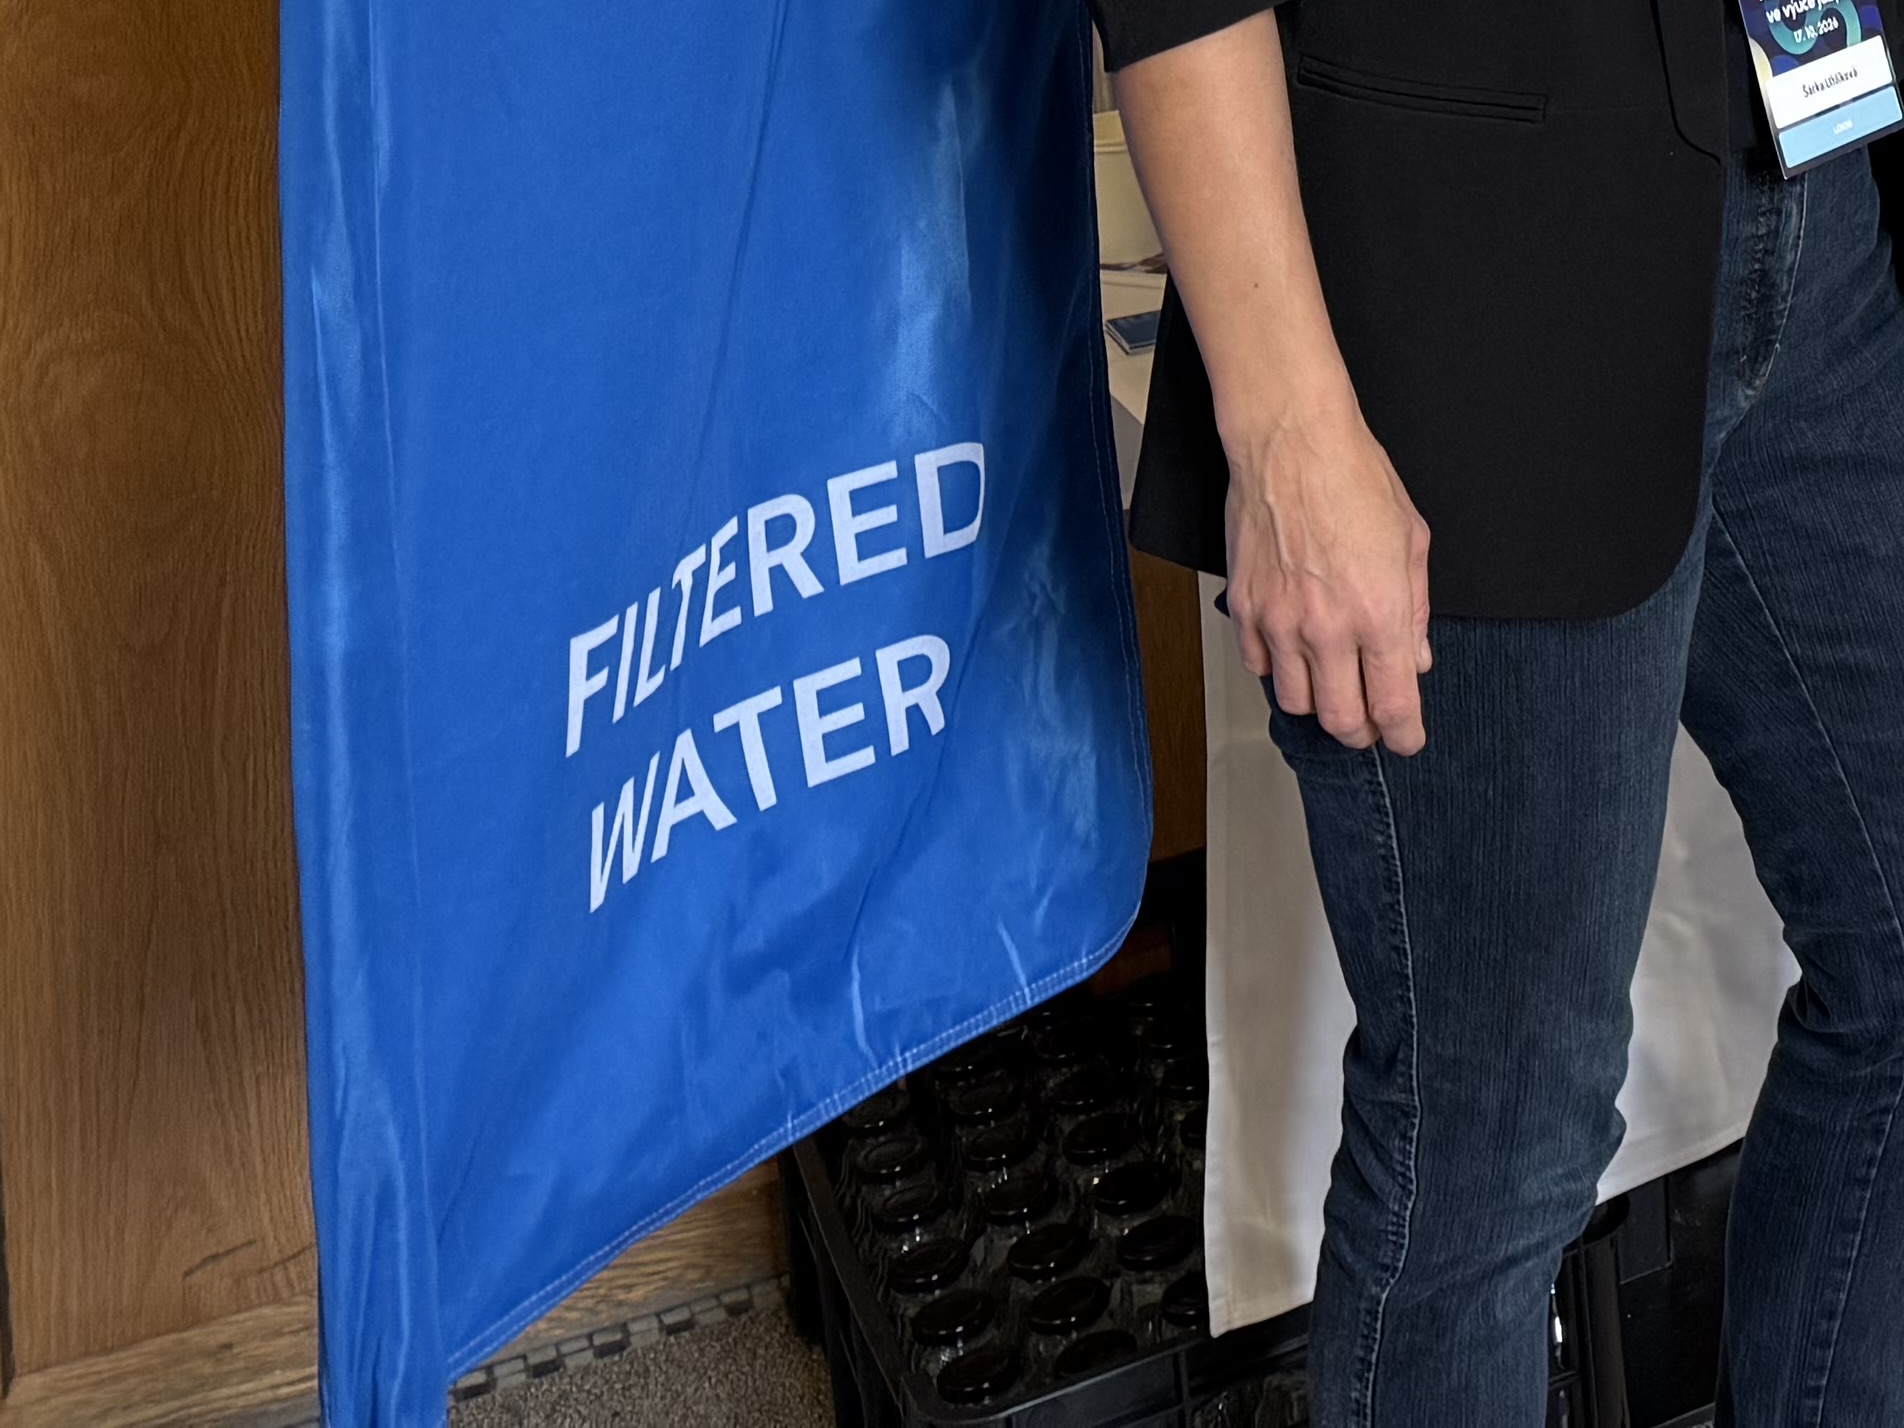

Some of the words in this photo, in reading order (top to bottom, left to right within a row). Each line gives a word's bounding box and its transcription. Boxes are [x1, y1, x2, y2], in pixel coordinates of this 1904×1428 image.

[1765, 5, 1781, 25] ve
[565, 441, 986, 759] FILTERED
[589, 633, 951, 914] WATER
